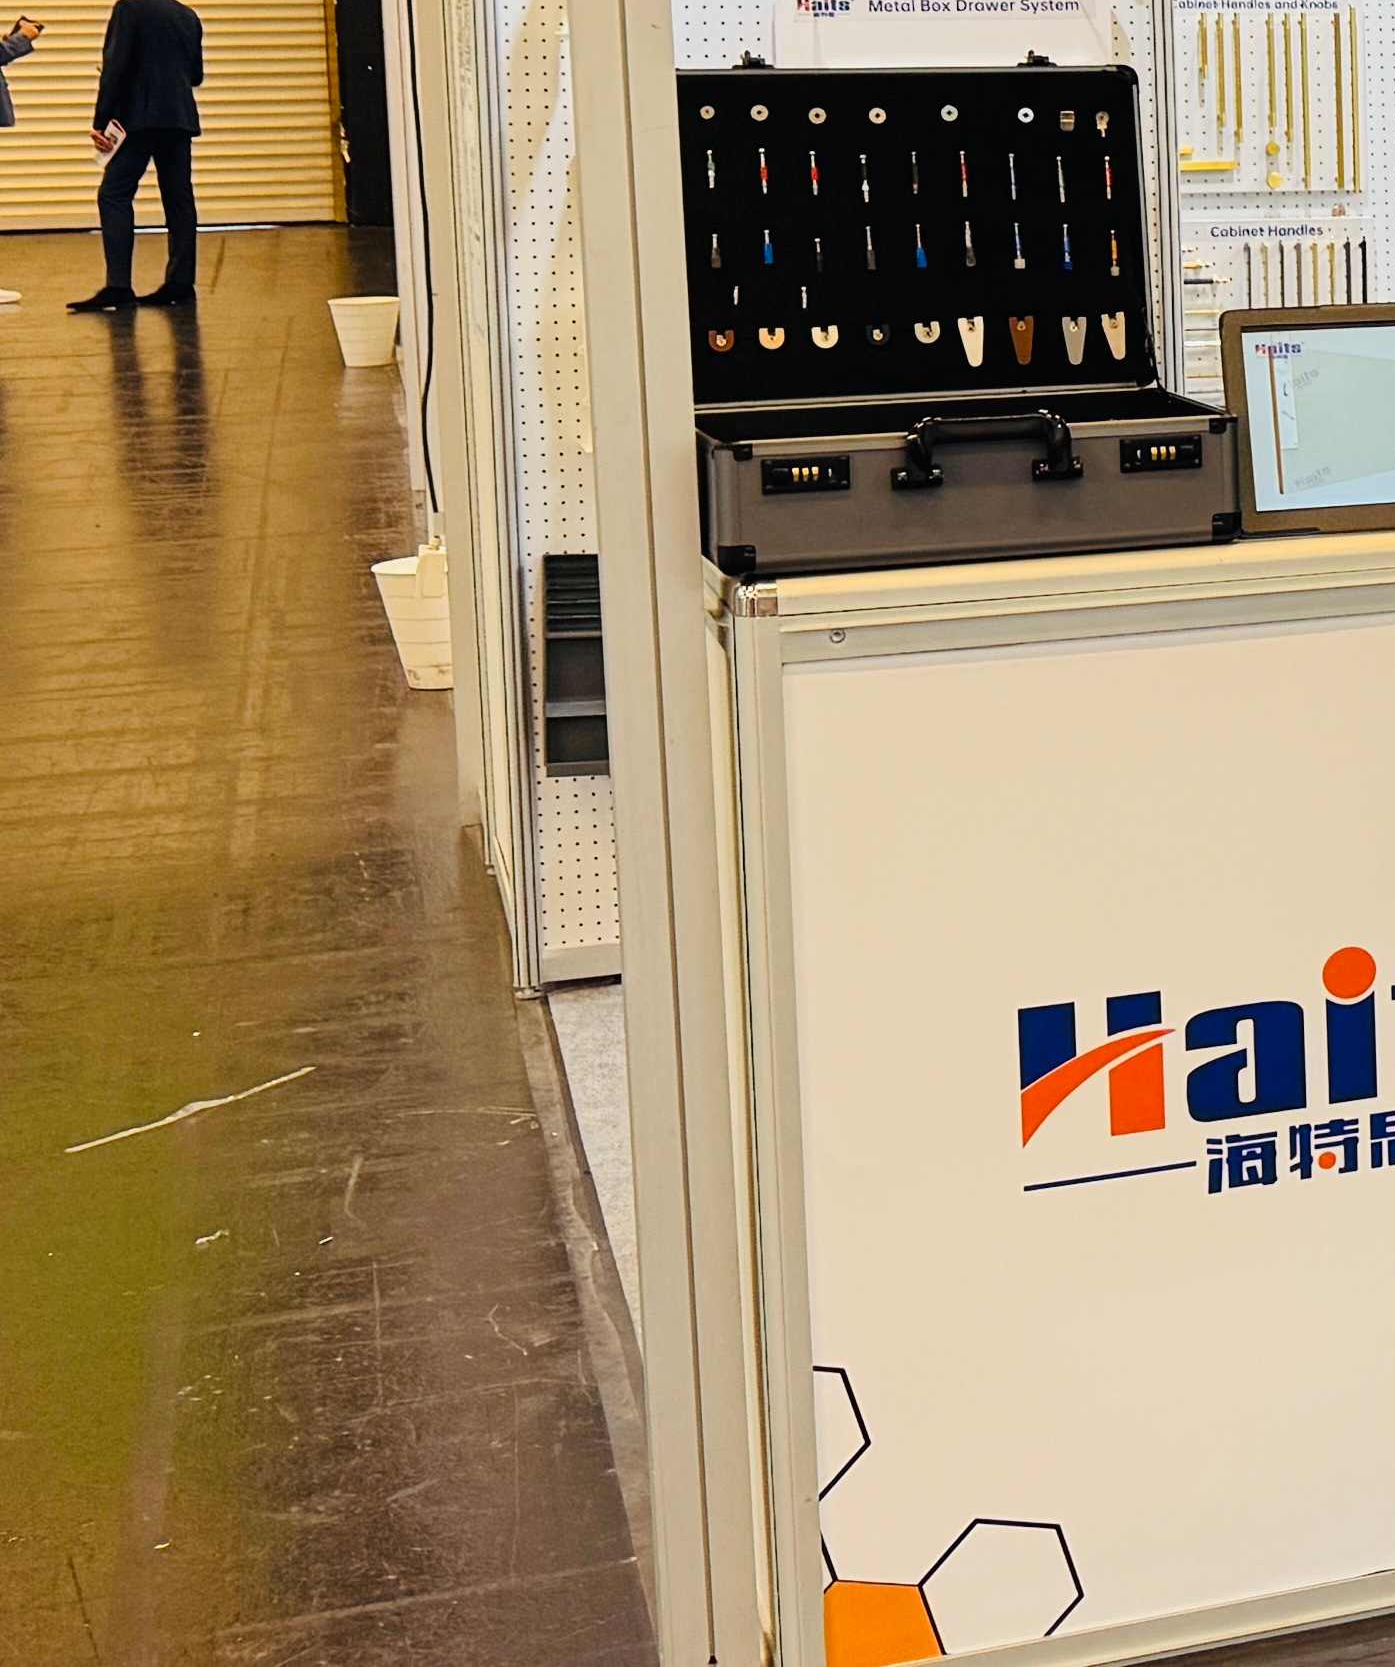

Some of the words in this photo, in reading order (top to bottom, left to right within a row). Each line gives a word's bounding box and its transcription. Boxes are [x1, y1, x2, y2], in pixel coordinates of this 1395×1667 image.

[920, 0, 951, 13] Box
[1274, 0, 1298, 10] and
[1210, 225, 1263, 238] Cabinet
[1267, 225, 1323, 238] Handles
